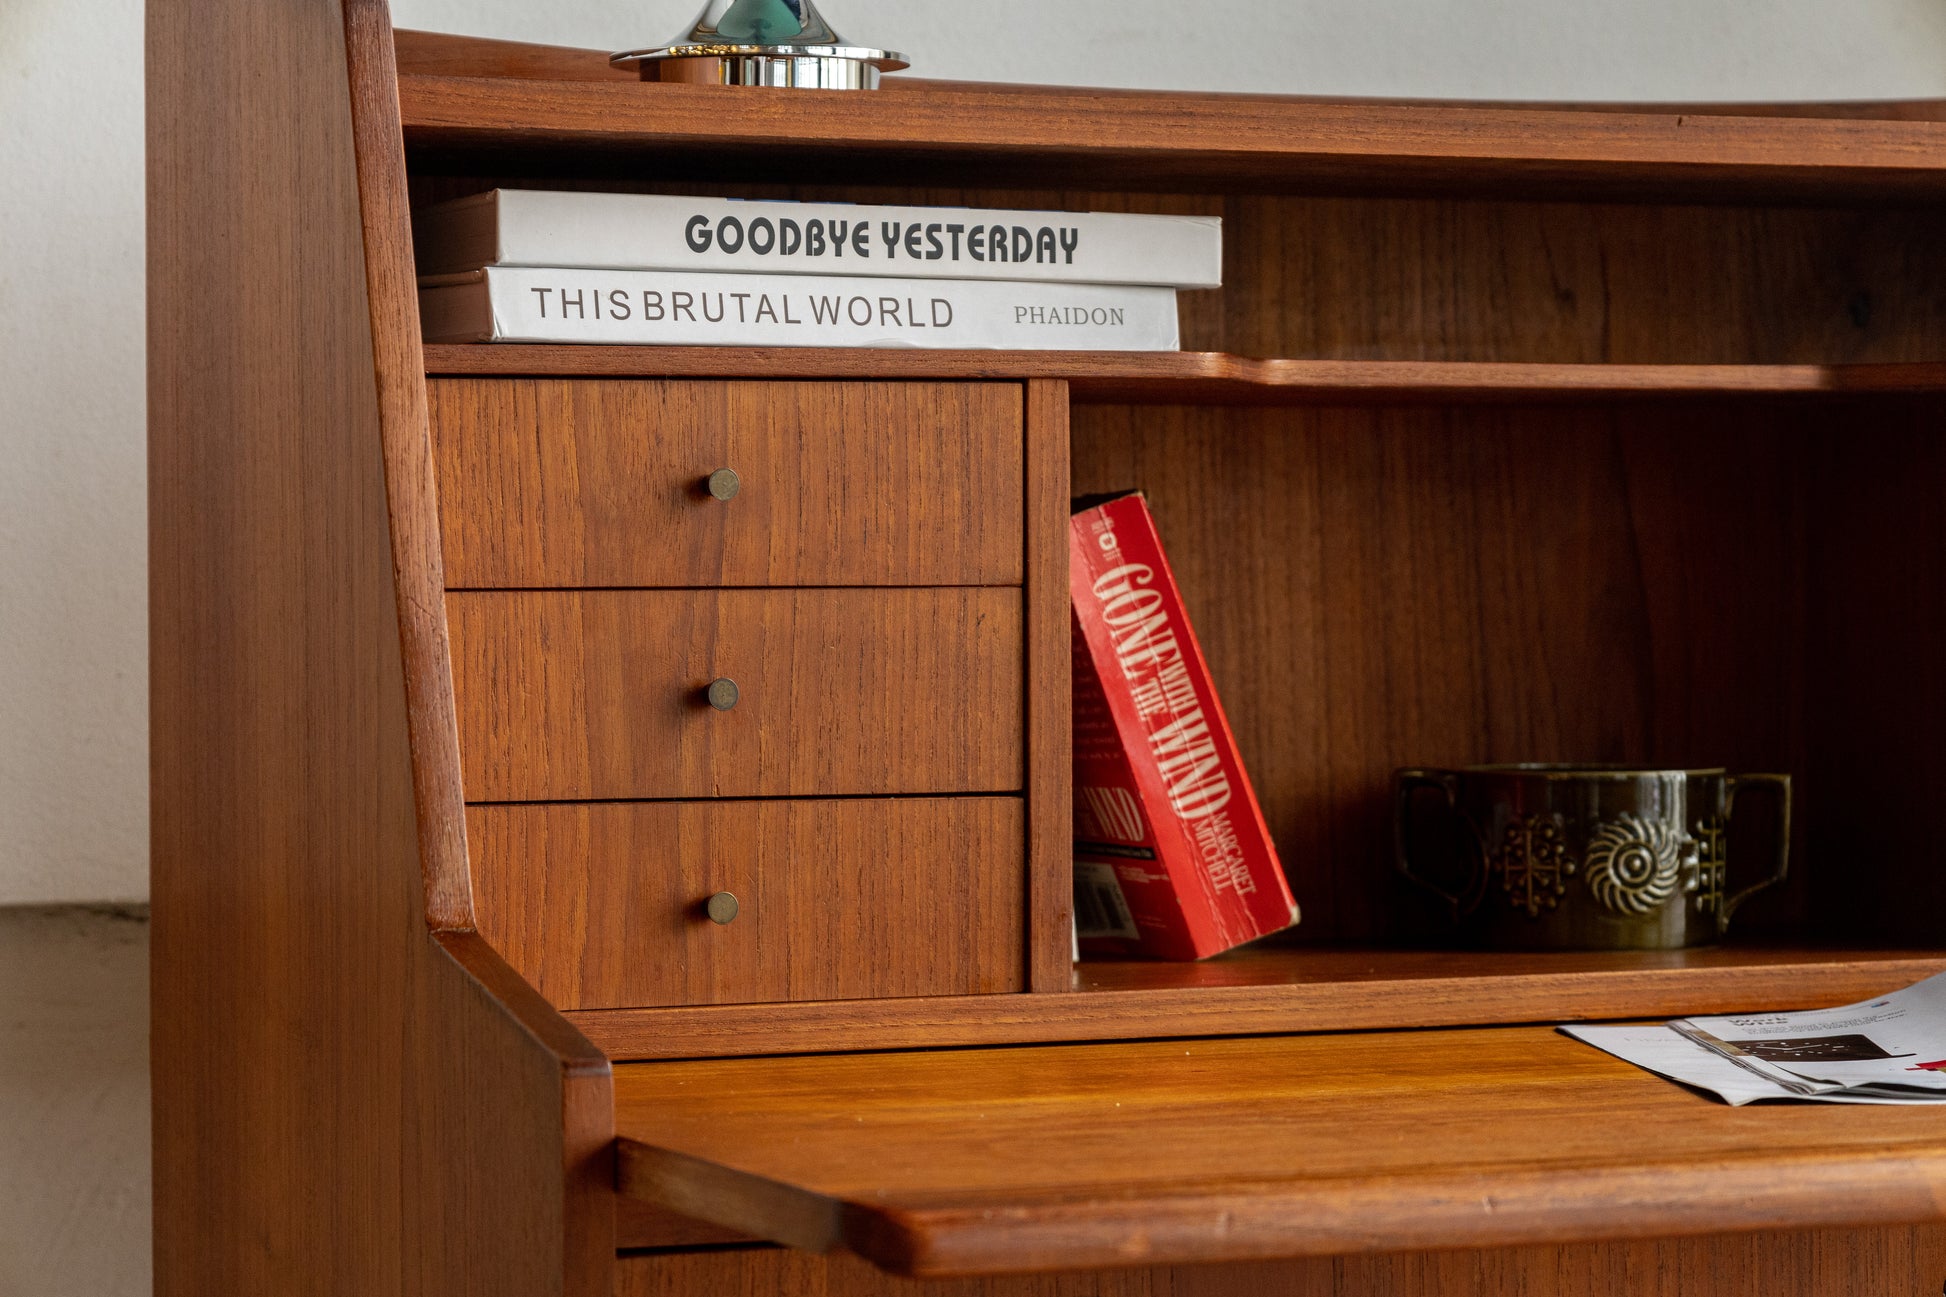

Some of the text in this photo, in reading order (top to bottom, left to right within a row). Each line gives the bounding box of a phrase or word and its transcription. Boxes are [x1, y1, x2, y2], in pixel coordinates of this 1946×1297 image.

[684, 214, 1078, 265] GOODBYE YESTERDAY
[530, 287, 953, 328] THIS BRUTAL WORLD
[1014, 306, 1124, 326] PHAIDON
[1093, 563, 1182, 681] GONE
[1130, 676, 1169, 723] THE
[1157, 659, 1199, 714] WITH
[1148, 706, 1232, 820] WIND
[1192, 818, 1234, 896] MITCHELL
[1211, 810, 1257, 896] MARGARET
